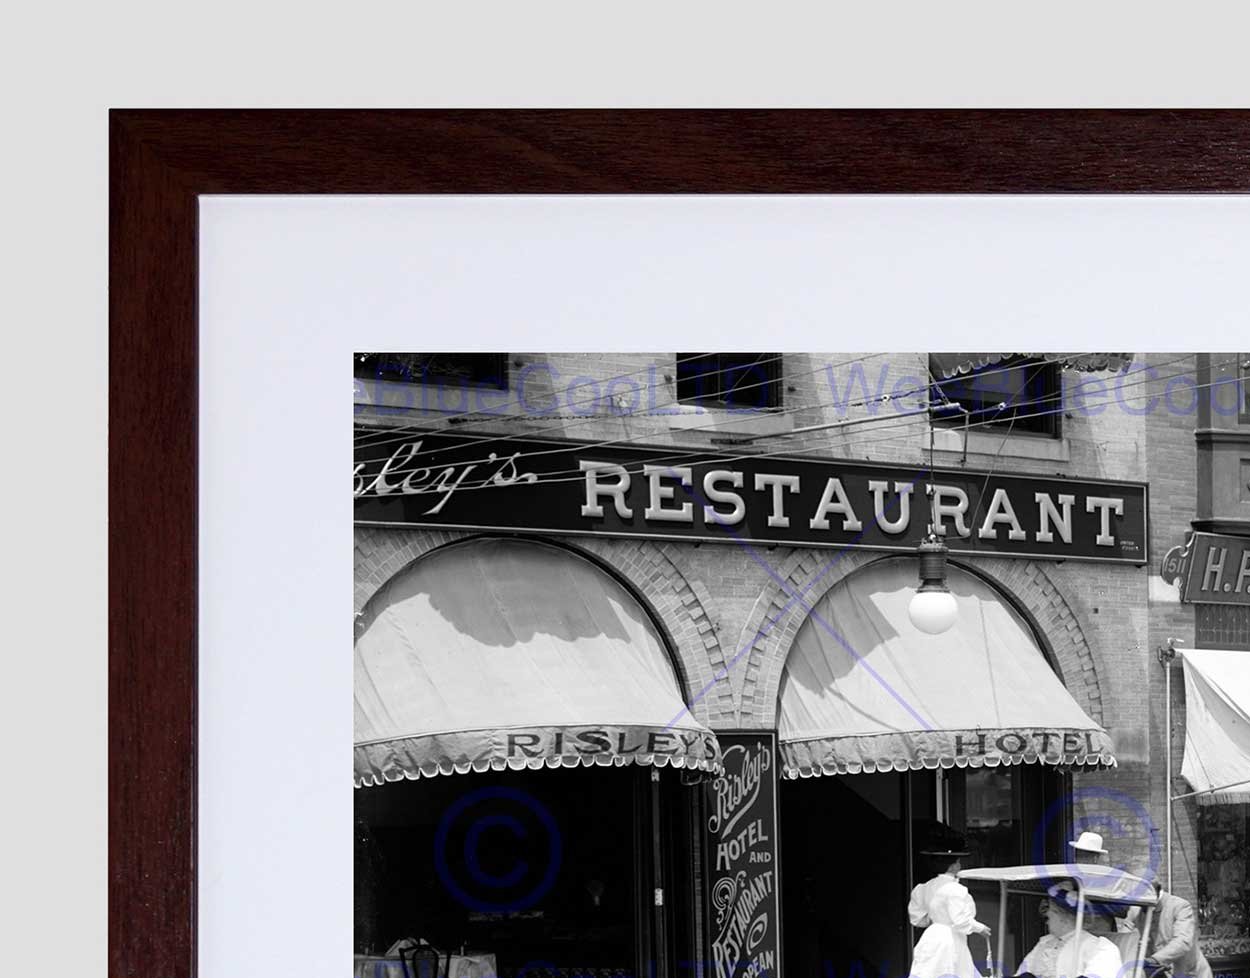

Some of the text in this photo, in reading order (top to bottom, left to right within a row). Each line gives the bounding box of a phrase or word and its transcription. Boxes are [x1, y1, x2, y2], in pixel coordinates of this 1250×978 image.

[579, 460, 1124, 546] RESTAURANT
[955, 732, 1104, 756] HOTEL
[716, 819, 768, 871] HOTEL
[749, 851, 772, 863] AND
